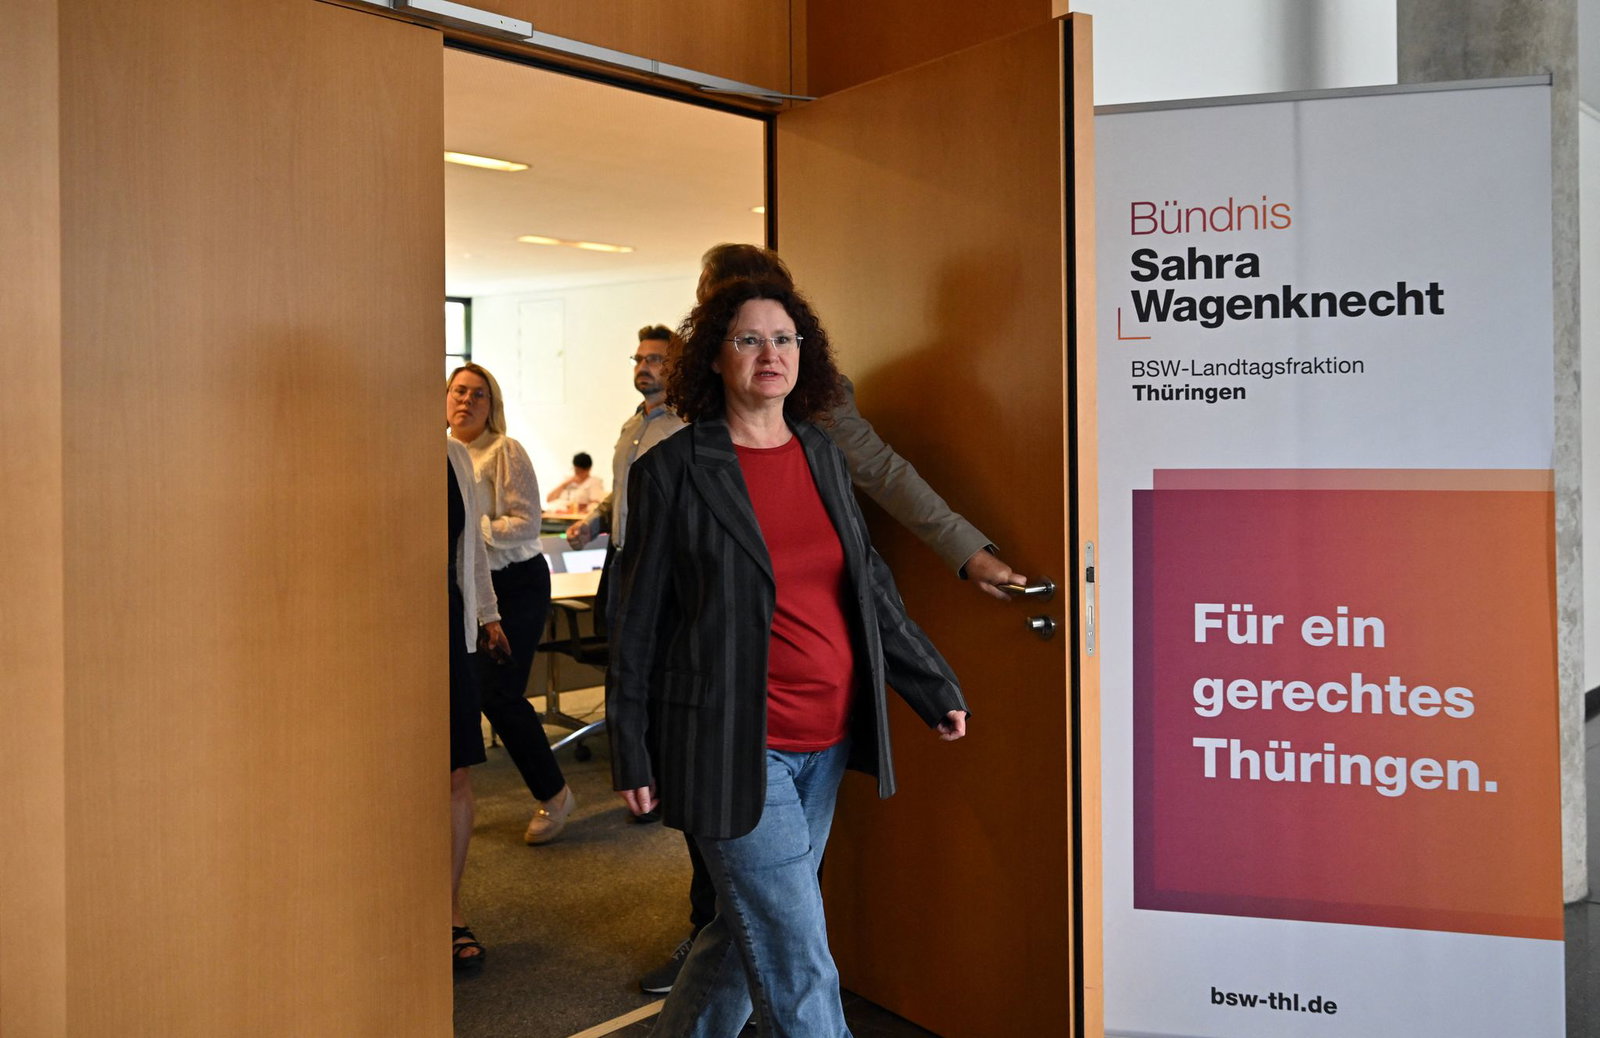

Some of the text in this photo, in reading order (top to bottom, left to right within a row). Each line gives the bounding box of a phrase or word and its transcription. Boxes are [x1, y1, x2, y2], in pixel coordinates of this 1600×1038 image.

[1130, 195, 1292, 236] Bündnis
[1130, 247, 1260, 283] Sahra
[1131, 281, 1445, 329] Wagenknecht
[1131, 357, 1365, 379] BSW-Landtagsfraktion
[1132, 384, 1246, 403] Thüringen
[1193, 602, 1385, 648] Für ein
[1192, 673, 1475, 719] gerechtes
[1192, 737, 1498, 797] Thüringen.
[1210, 987, 1338, 1015] bsw-thl.de
